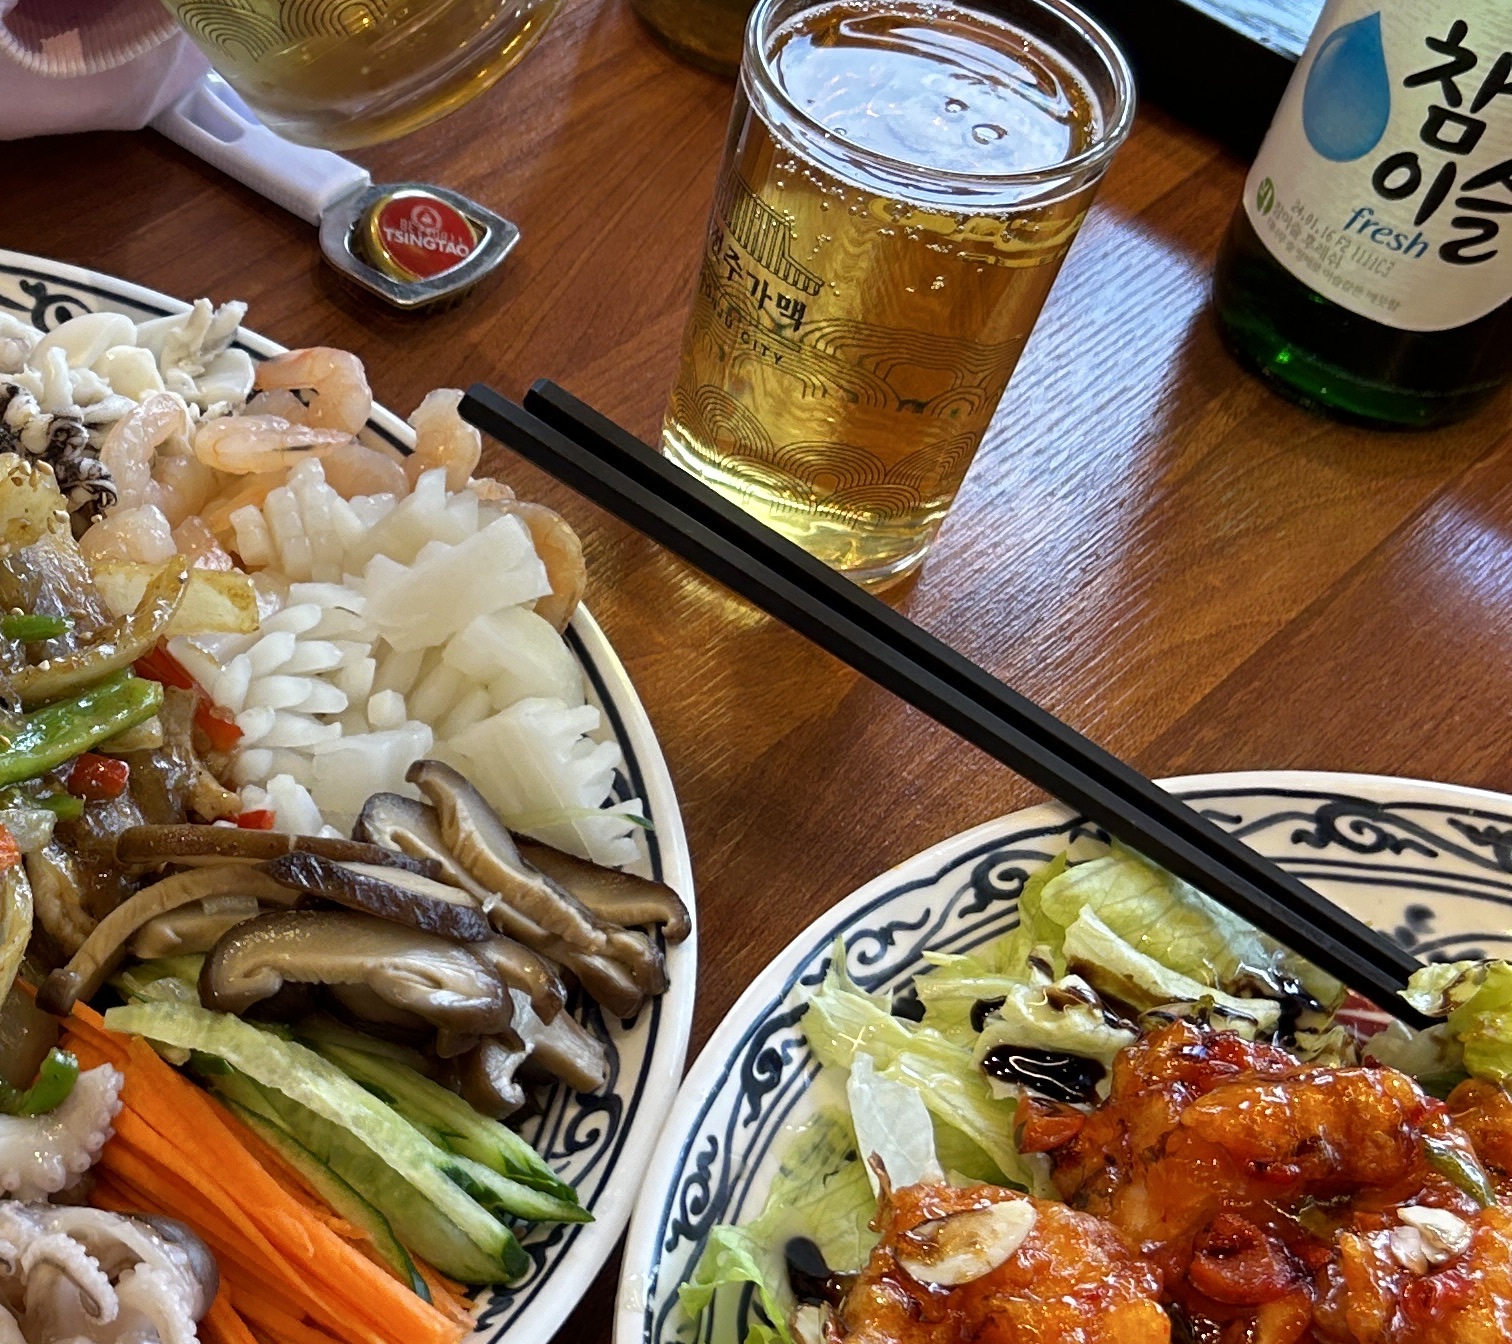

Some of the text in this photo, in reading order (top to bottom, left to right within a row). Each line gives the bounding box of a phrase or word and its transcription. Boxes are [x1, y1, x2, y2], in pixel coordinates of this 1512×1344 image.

[383, 225, 470, 258] TSINGTAO
[1343, 207, 1429, 260] fresh
[740, 331, 783, 365] CITY
